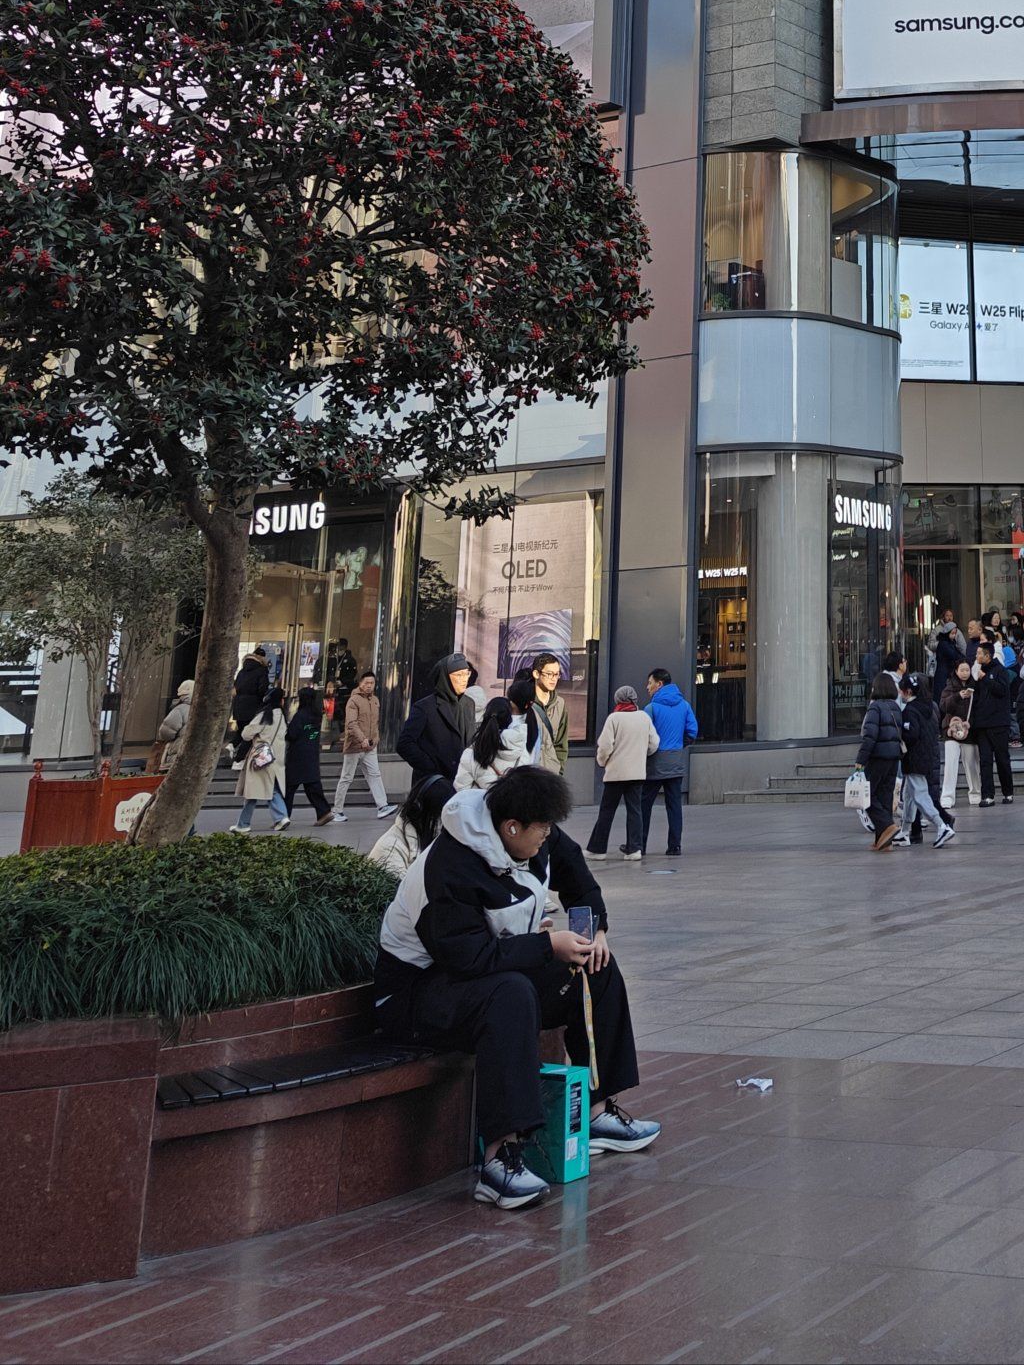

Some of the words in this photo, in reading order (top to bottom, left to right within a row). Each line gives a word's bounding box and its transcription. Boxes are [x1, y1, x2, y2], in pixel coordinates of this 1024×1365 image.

[919, 302, 943, 315] 三星
[980, 304, 1006, 317] W25
[930, 320, 962, 333] Galaxy
[249, 502, 325, 535] SUNG
[835, 494, 892, 531] SAMSUNG
[493, 539, 558, 554] 三星AI电视新纪元
[502, 559, 547, 579] OLED
